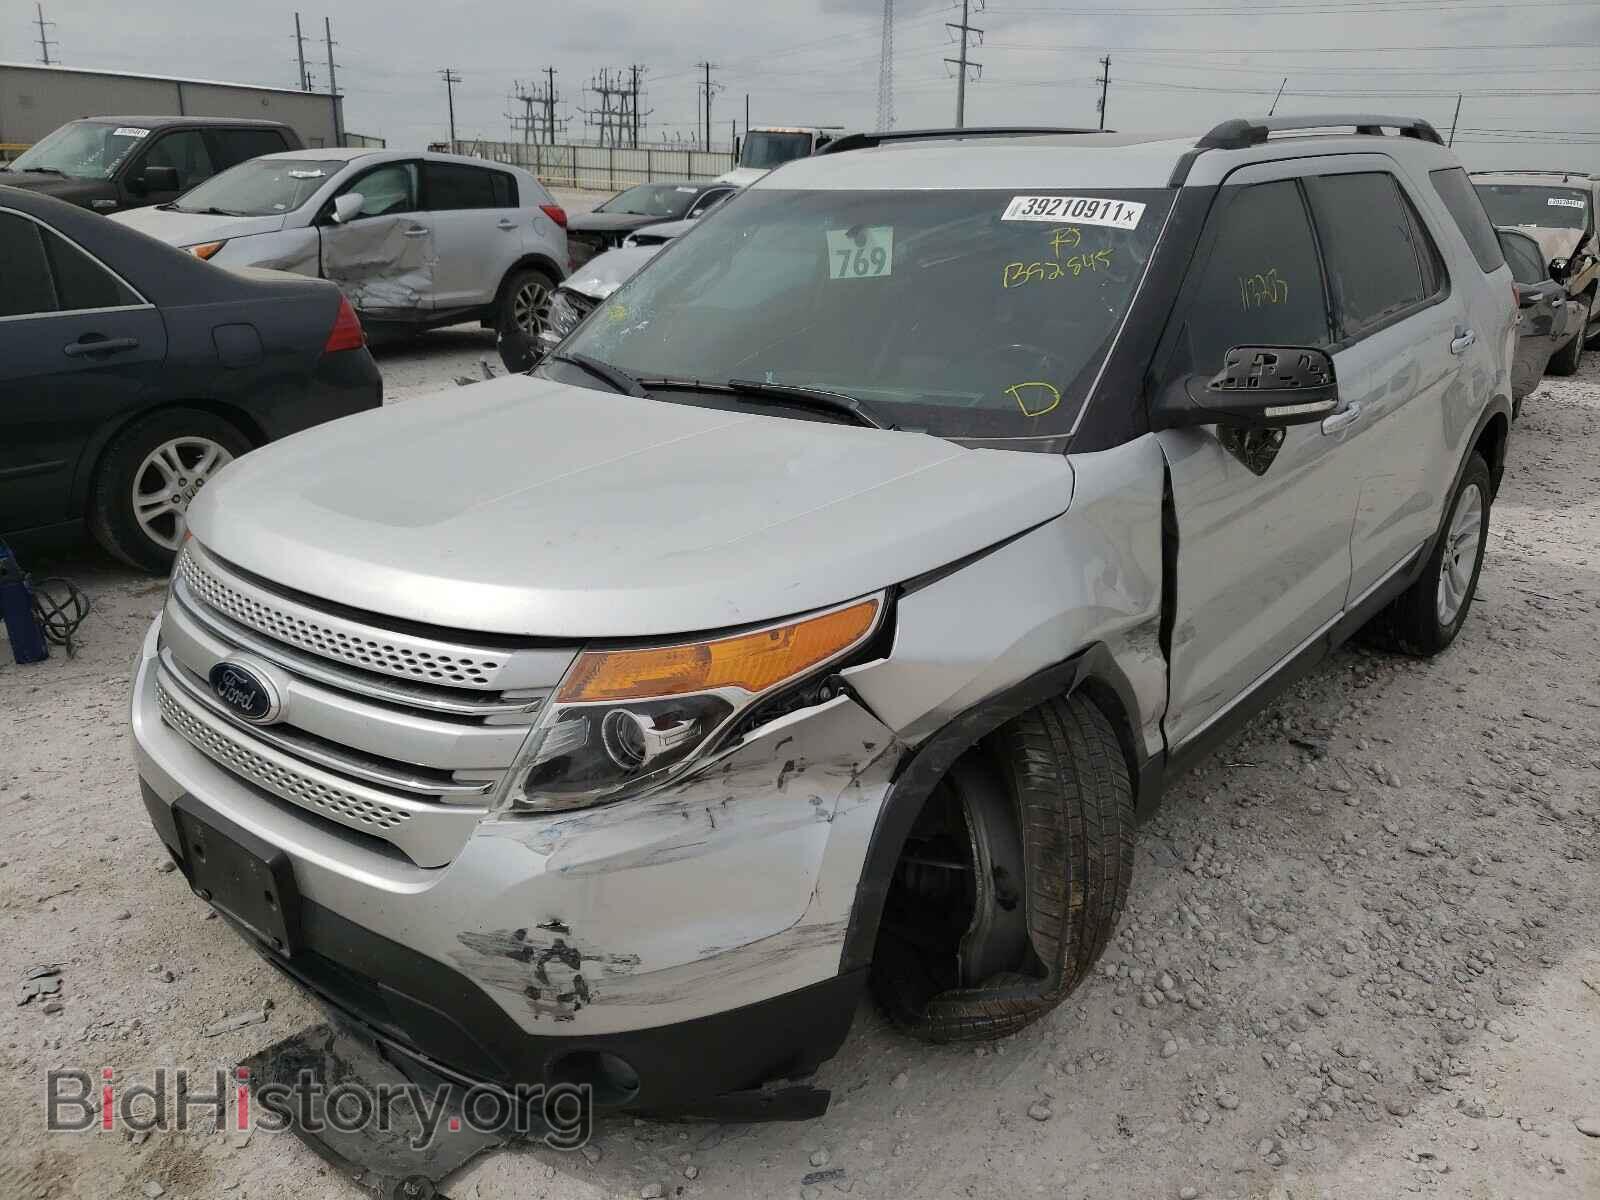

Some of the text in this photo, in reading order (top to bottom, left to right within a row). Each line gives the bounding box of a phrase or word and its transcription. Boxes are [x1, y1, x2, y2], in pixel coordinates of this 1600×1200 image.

[835, 247, 887, 277] 769
[1004, 382, 1061, 417] D
[217, 669, 257, 711] Ford
